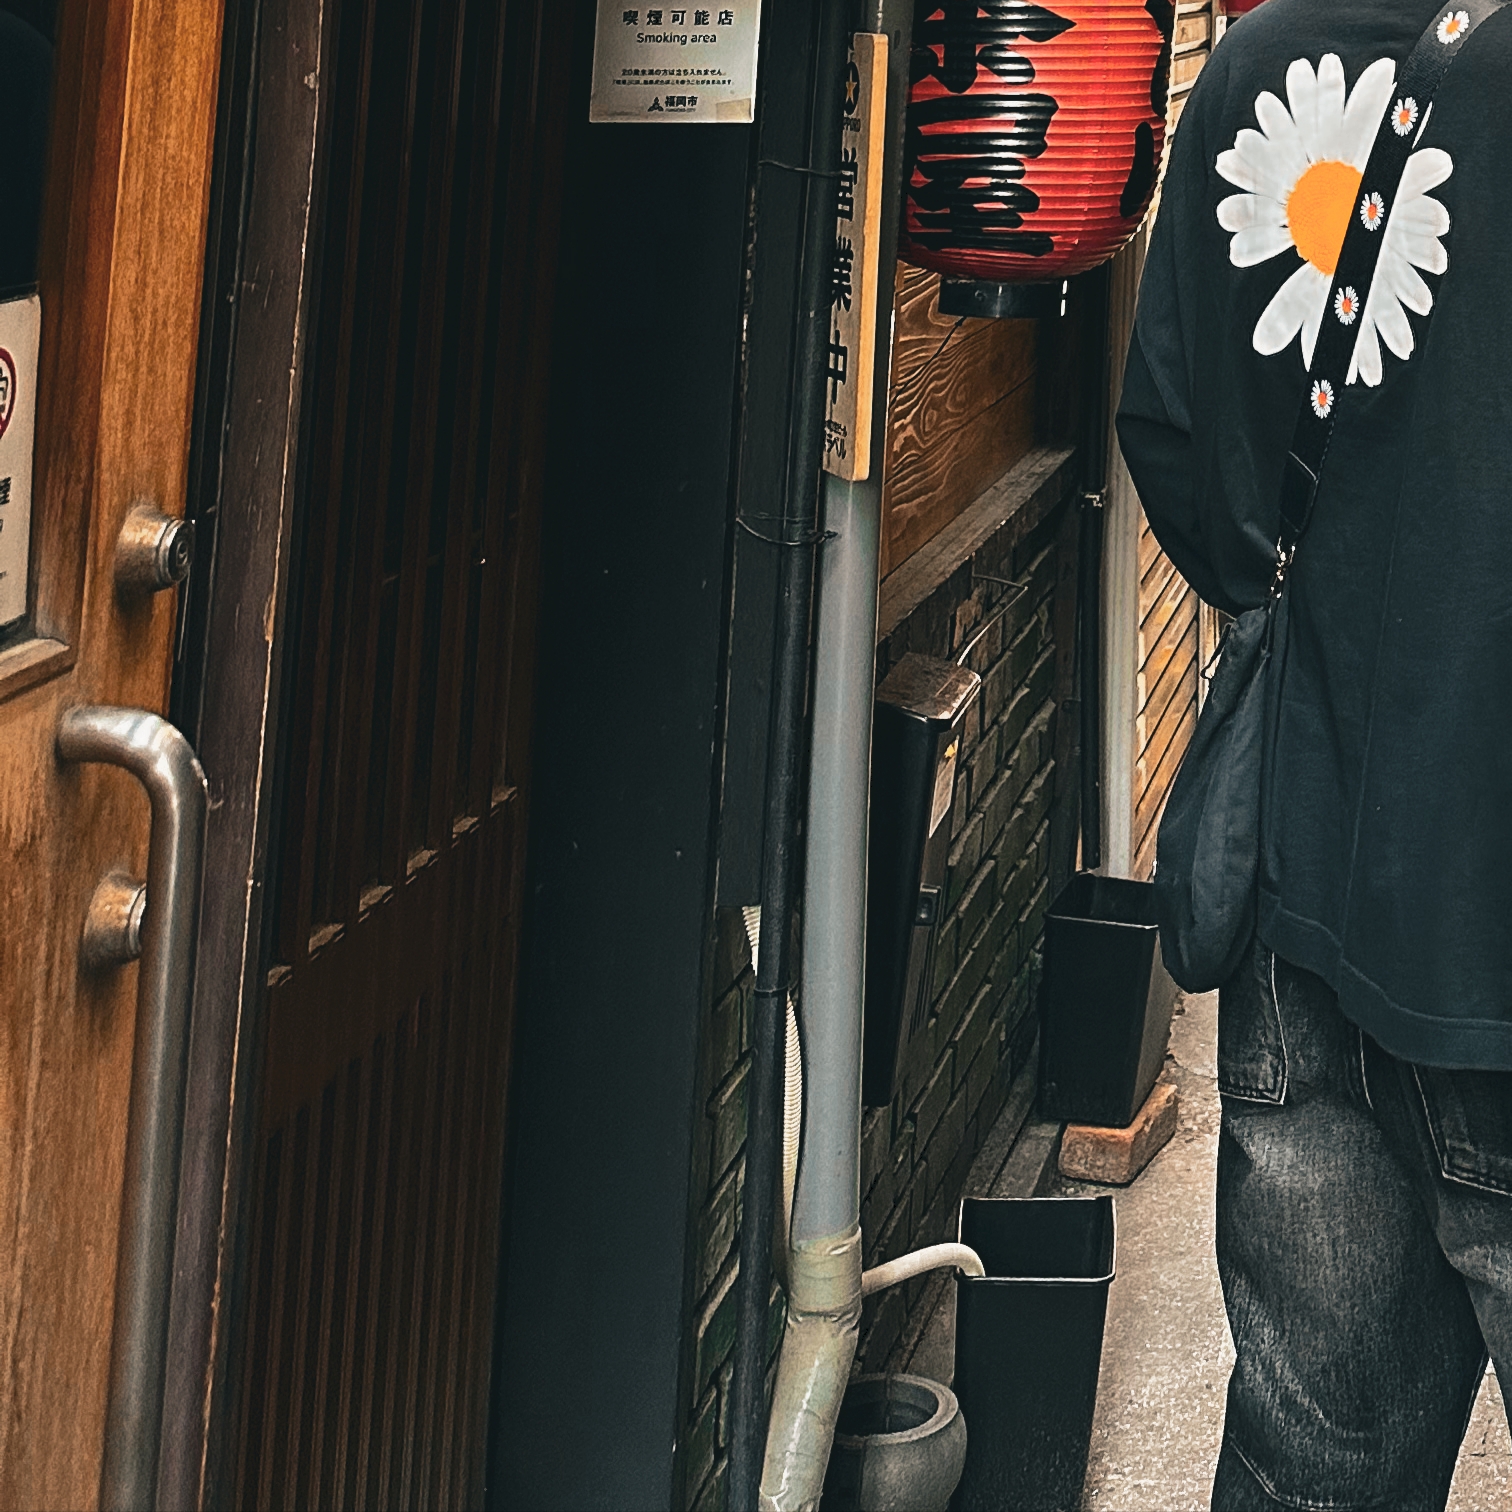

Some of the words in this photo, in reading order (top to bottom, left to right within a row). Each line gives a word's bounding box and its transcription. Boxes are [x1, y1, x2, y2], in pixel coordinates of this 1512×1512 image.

[622, 10, 734, 26] 喫煙可能店
[636, 32, 688, 46] Smoking
[690, 34, 717, 44] area
